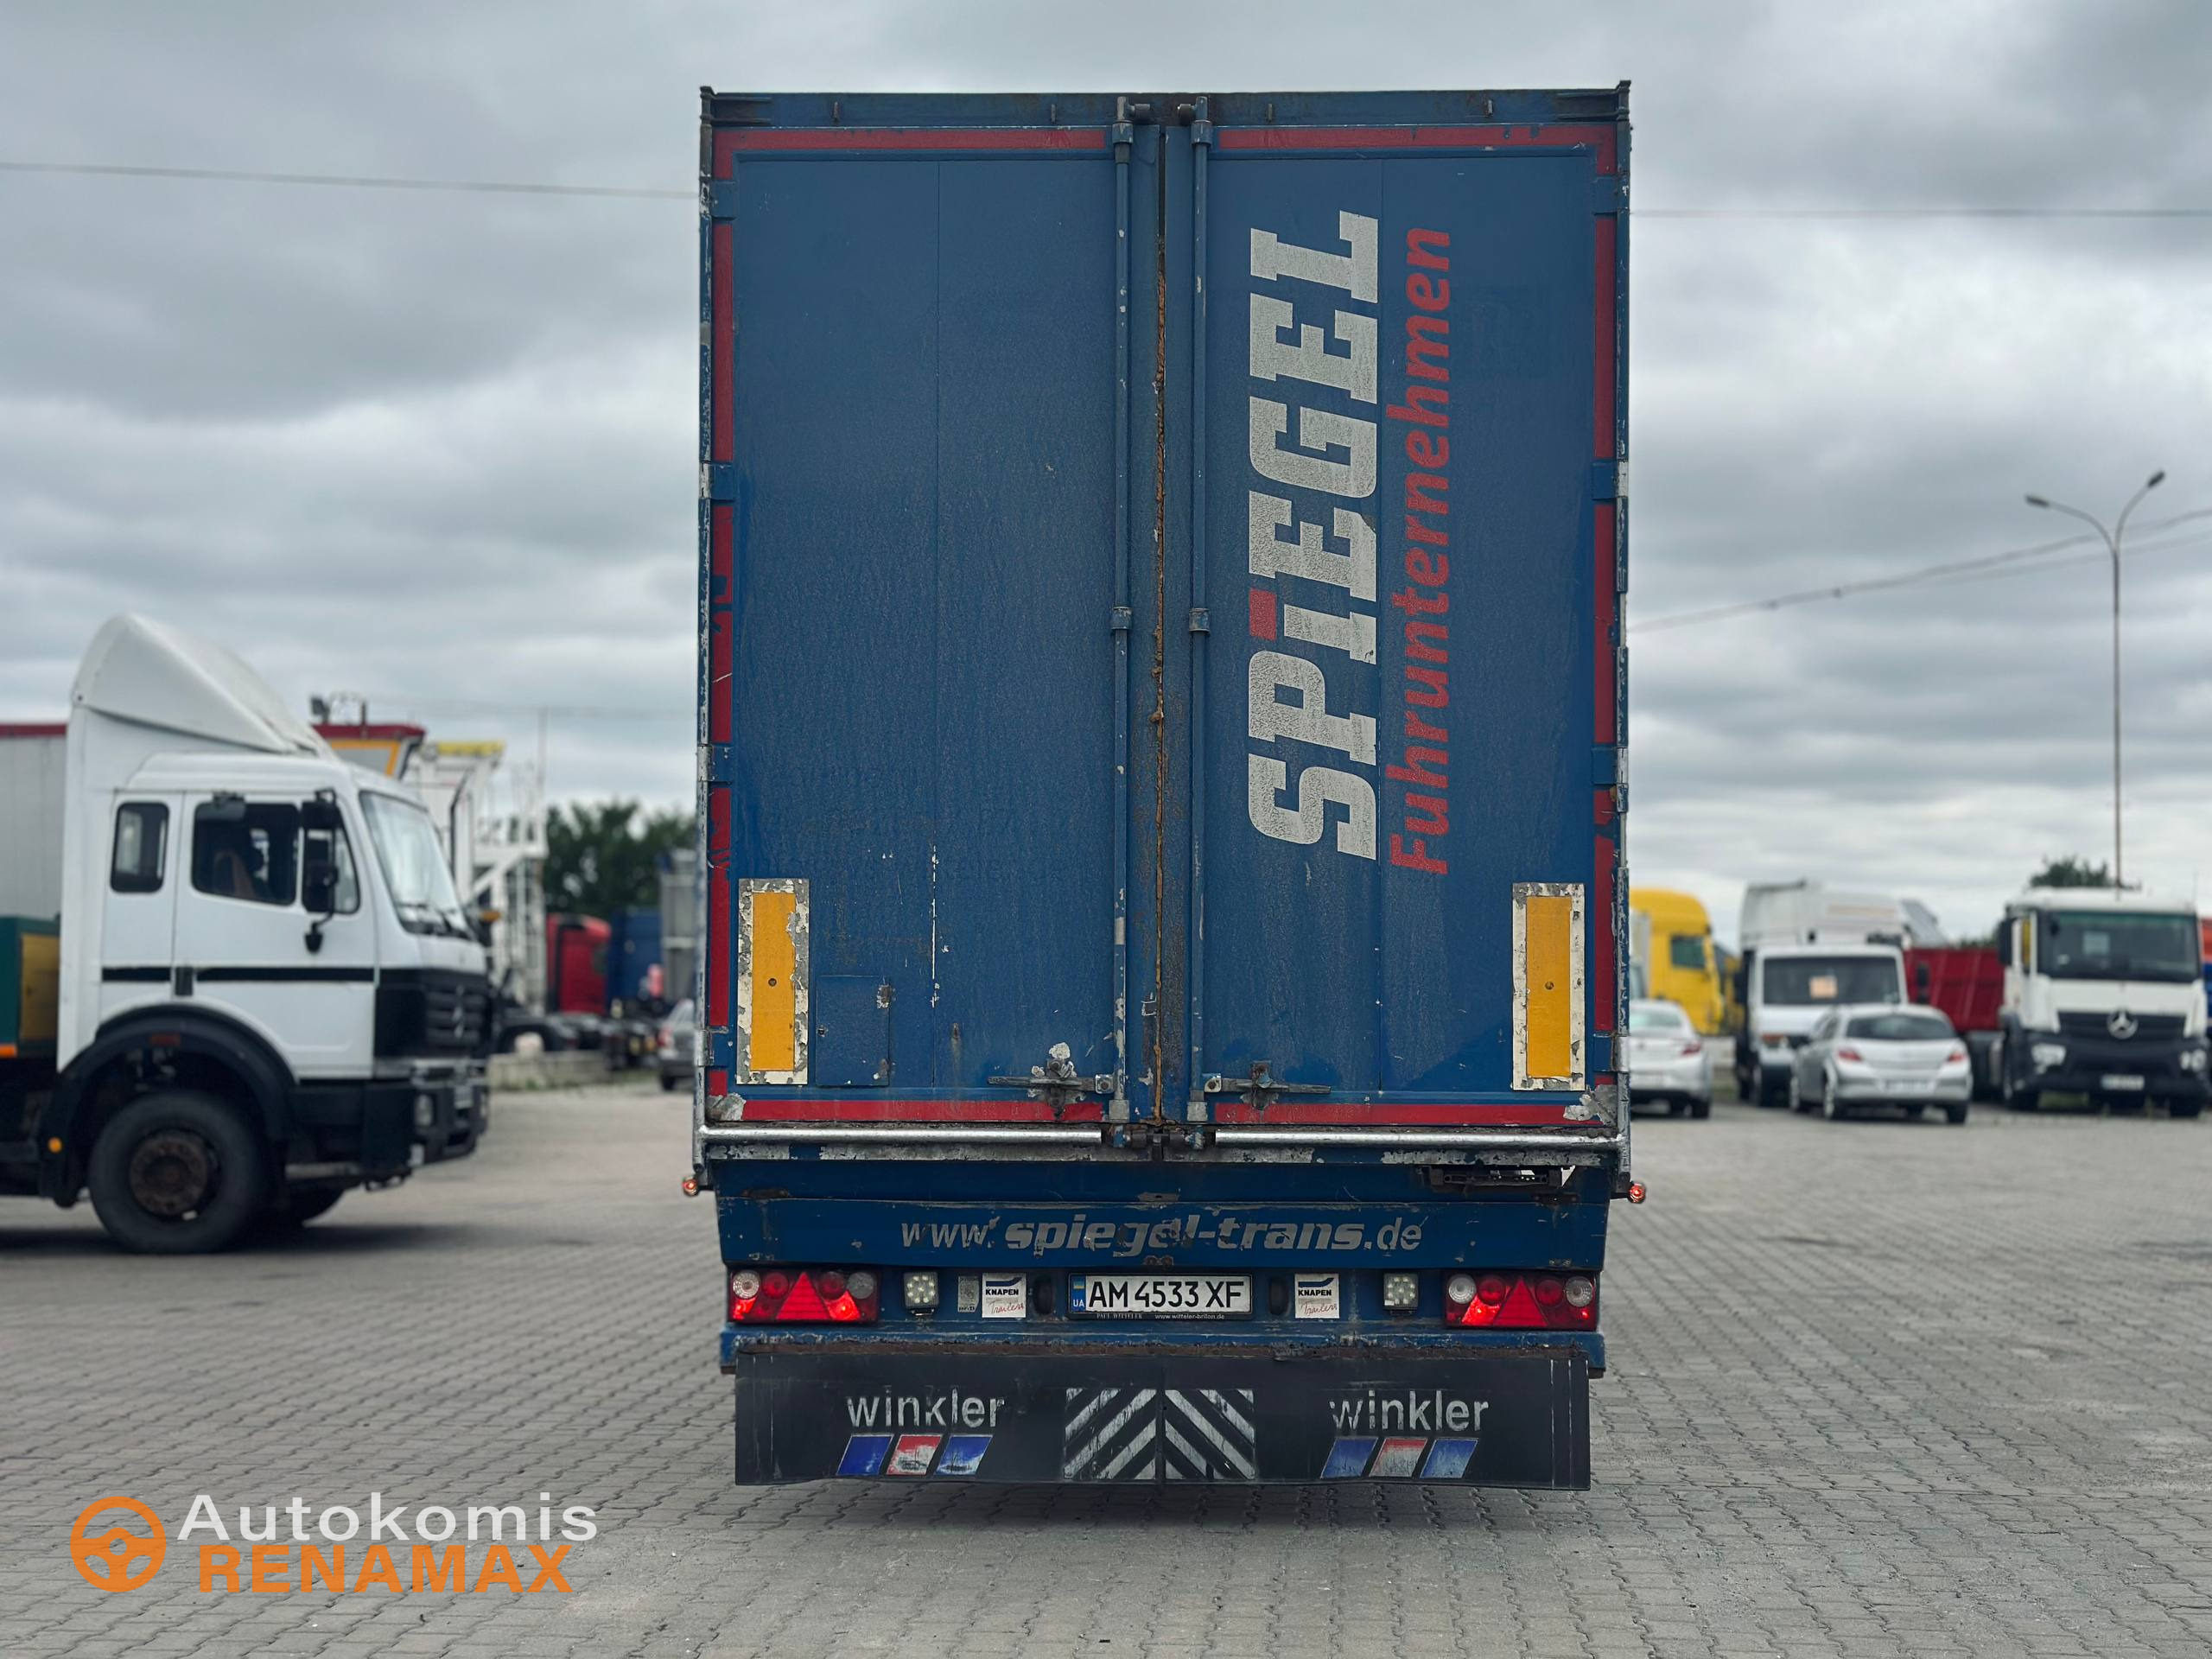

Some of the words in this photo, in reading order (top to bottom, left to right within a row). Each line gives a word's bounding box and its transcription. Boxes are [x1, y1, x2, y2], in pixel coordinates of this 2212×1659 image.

[1386, 227, 1452, 874] Fuhrunternehmen
[1072, 1299, 1085, 1307] UA
[1089, 1281, 1128, 1307] AM
[1135, 1281, 1199, 1307] 4533
[1205, 1281, 1244, 1308] XF
[846, 1386, 1005, 1427] winkler
[1329, 1389, 1489, 1431] winkler
